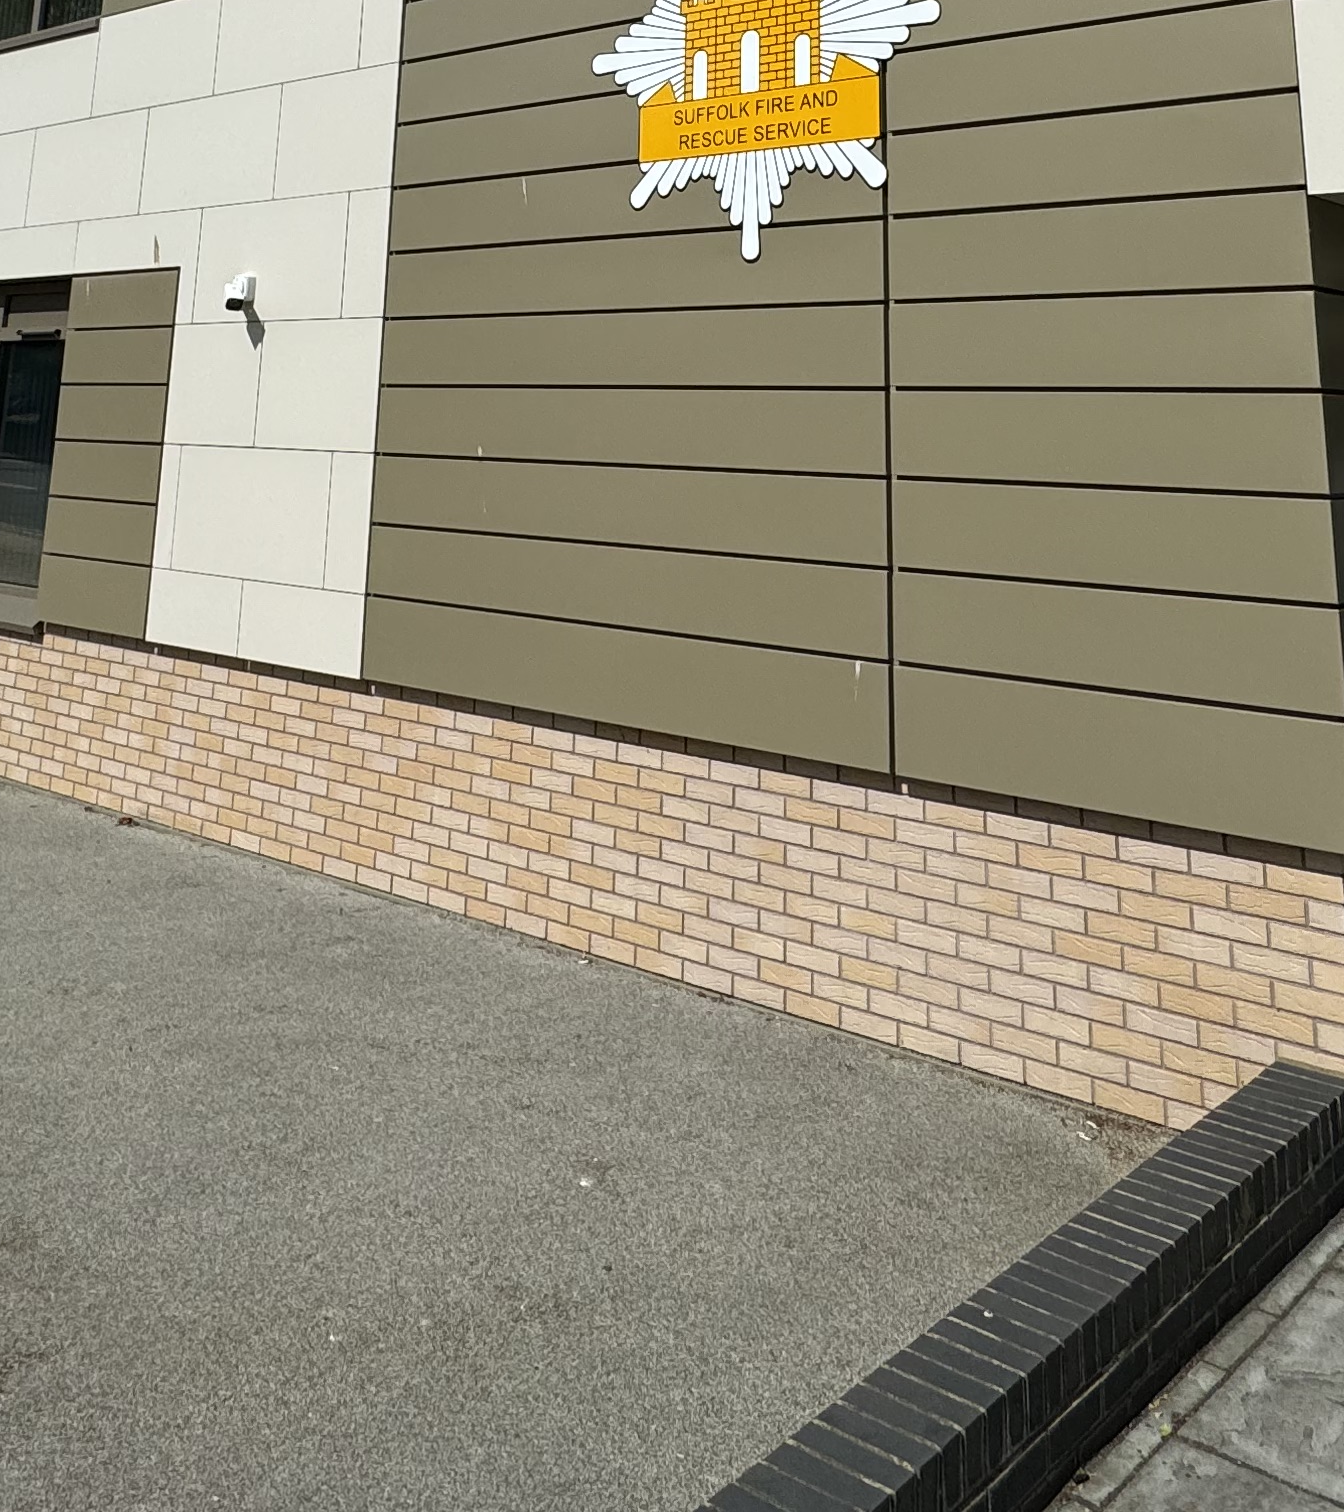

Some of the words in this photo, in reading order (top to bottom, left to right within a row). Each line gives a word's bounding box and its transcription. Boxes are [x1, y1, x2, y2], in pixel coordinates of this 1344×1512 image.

[673, 100, 750, 126] SUFFOLK
[755, 94, 795, 116] FIRE
[799, 89, 838, 111] AND
[679, 127, 747, 150] RESCUE
[753, 117, 832, 142] SERVICE
